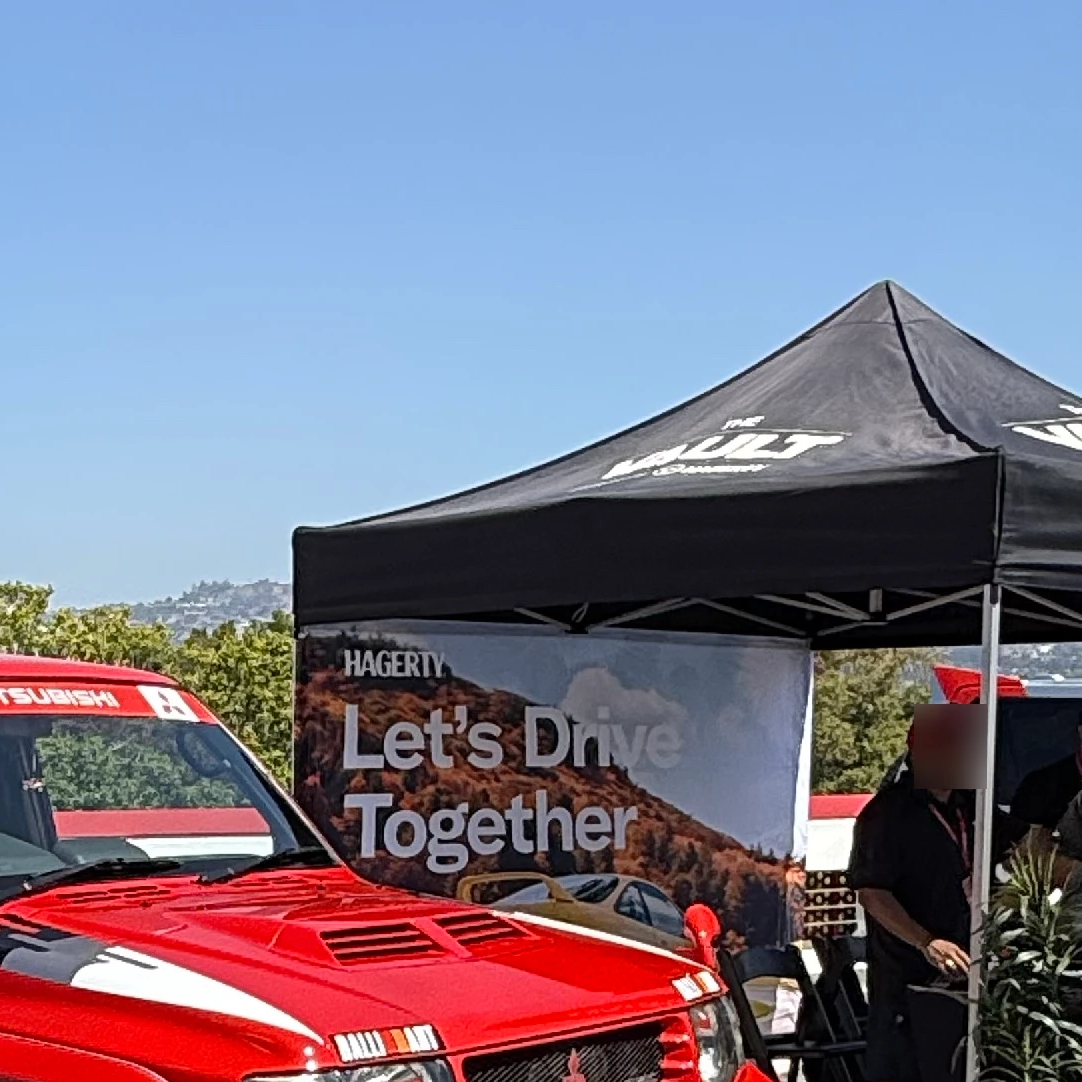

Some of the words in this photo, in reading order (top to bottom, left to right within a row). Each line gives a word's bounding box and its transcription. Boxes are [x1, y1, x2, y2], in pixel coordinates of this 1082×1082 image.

[601, 433, 845, 481] VAULT
[344, 649, 446, 678] HAGERTY
[342, 703, 503, 770] Let's
[524, 705, 682, 770] Drive
[342, 789, 638, 874] Together
